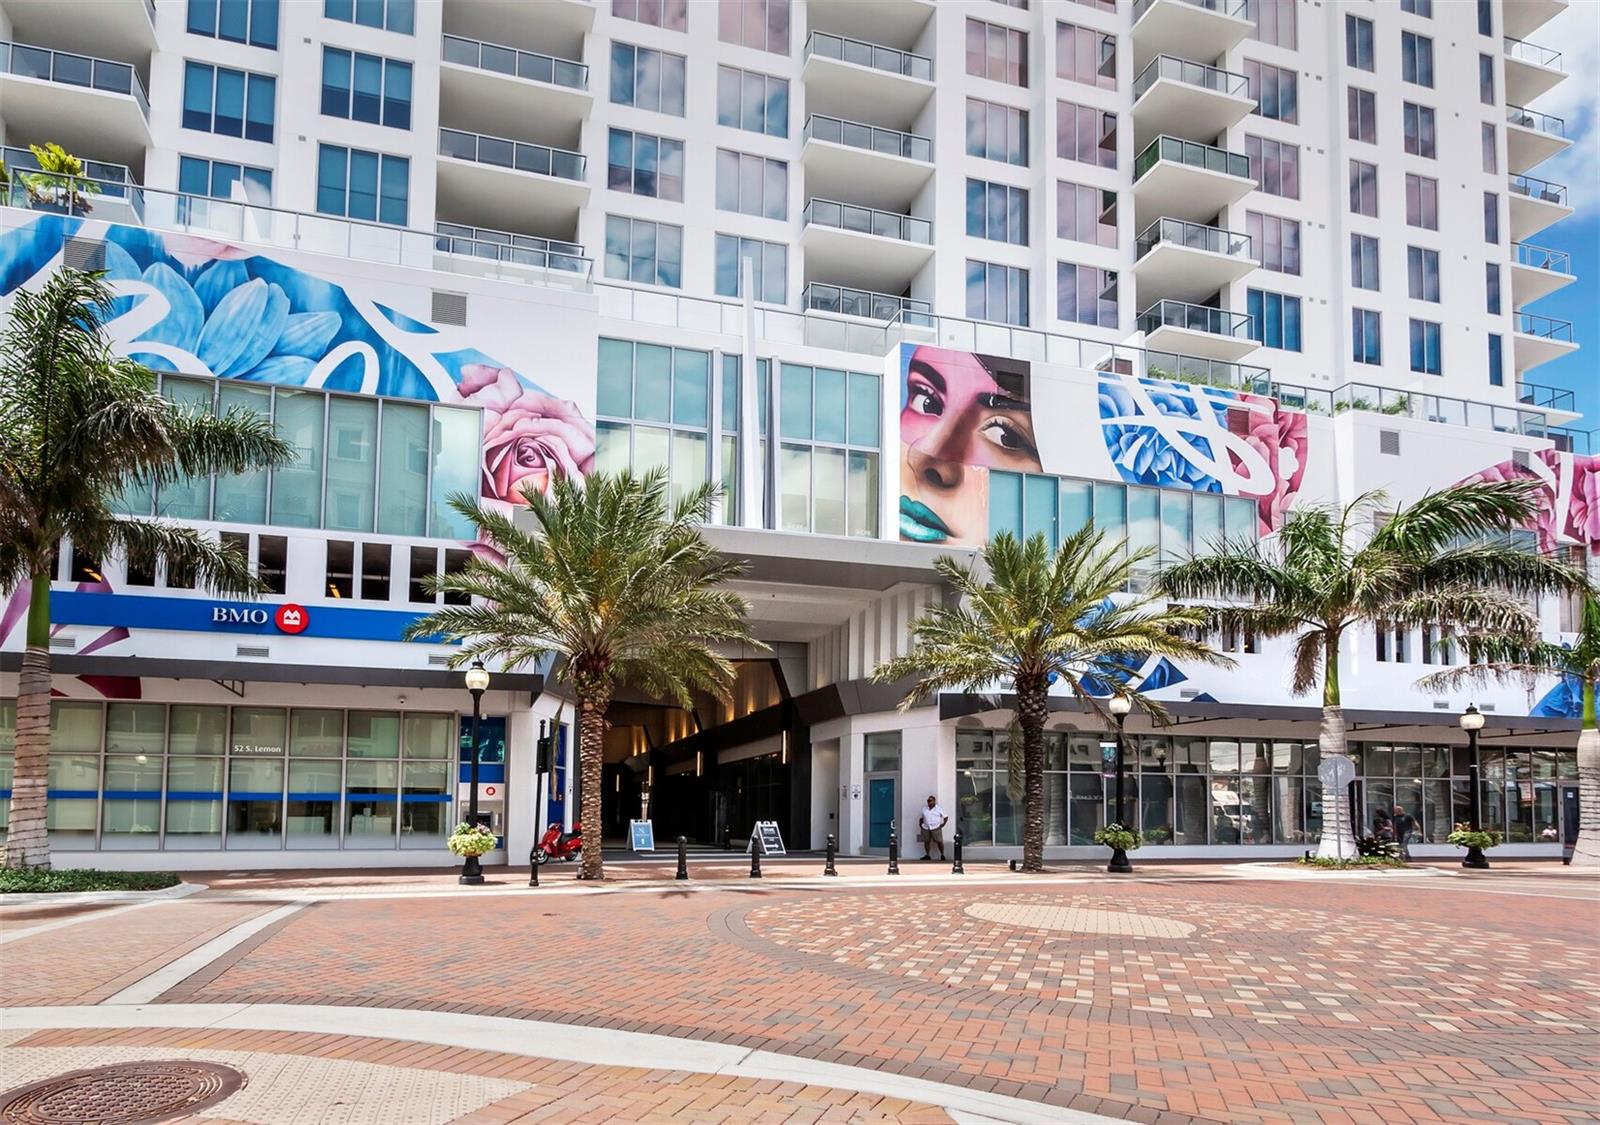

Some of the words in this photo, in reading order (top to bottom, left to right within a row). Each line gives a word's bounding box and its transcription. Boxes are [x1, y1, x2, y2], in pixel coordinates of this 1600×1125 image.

[212, 607, 268, 624] BMO
[234, 744, 244, 752] 52
[254, 745, 281, 753] Lemon
